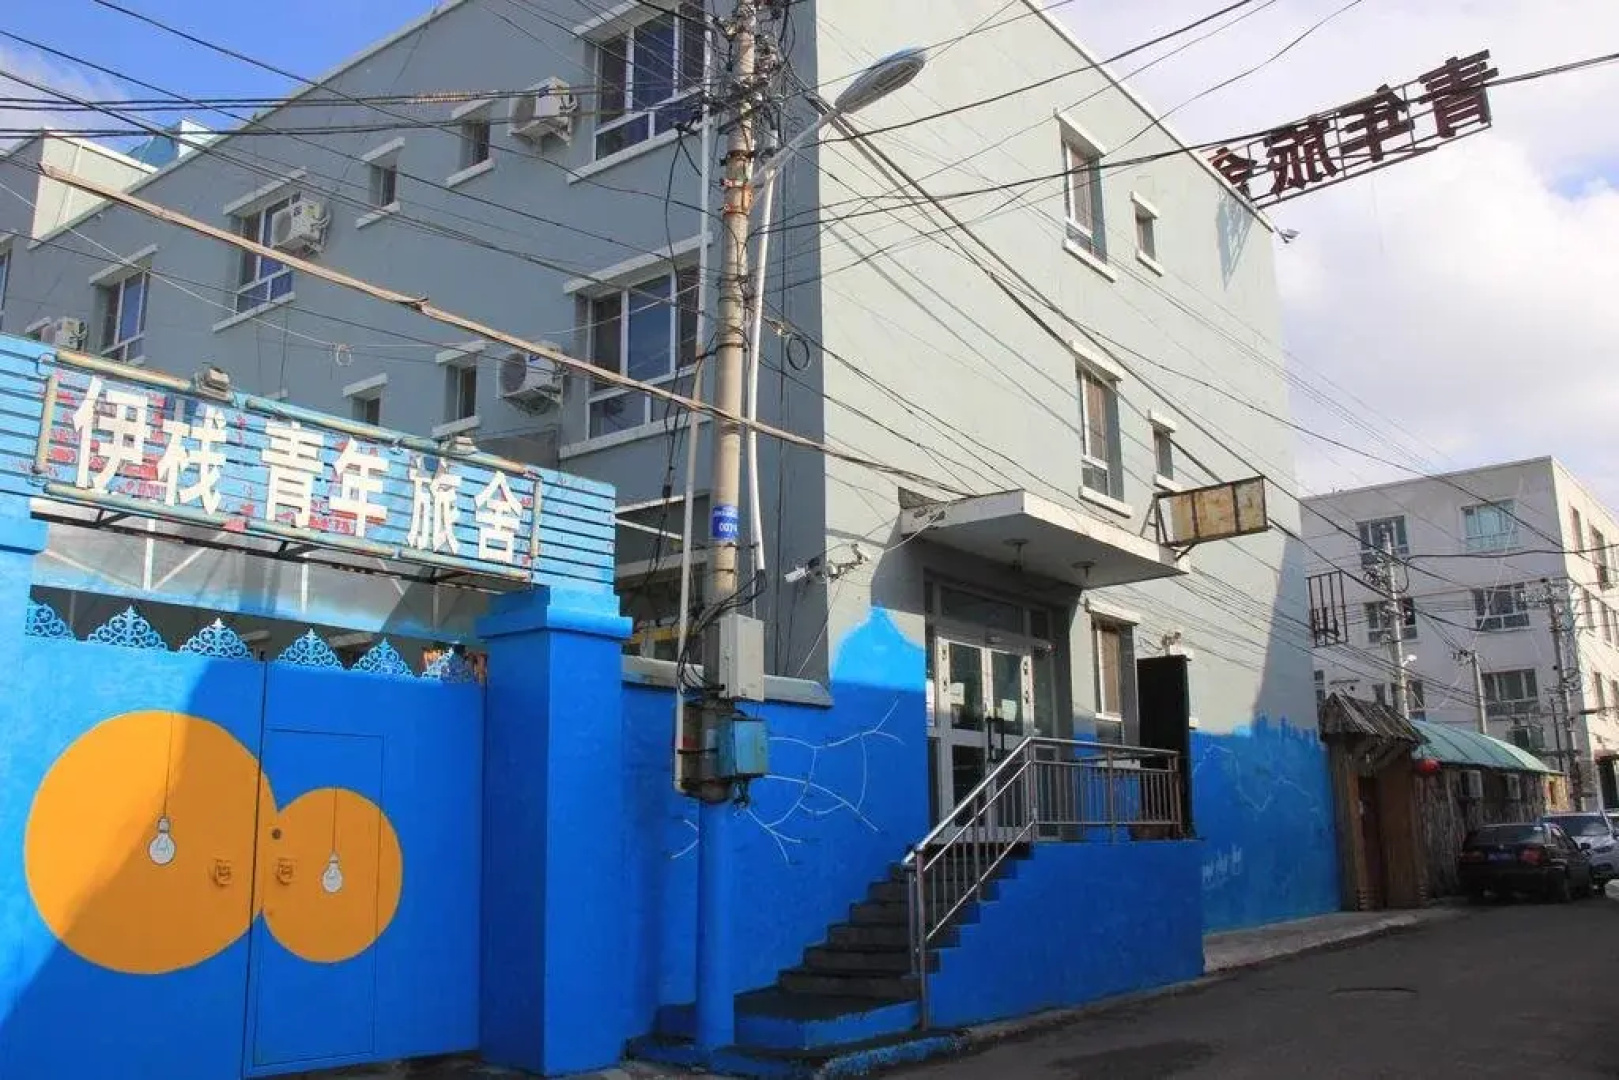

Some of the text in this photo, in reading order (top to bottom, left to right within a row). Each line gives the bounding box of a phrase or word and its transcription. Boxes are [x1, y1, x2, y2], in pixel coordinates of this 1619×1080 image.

[71, 376, 523, 563] 伊栈青年旅舍
